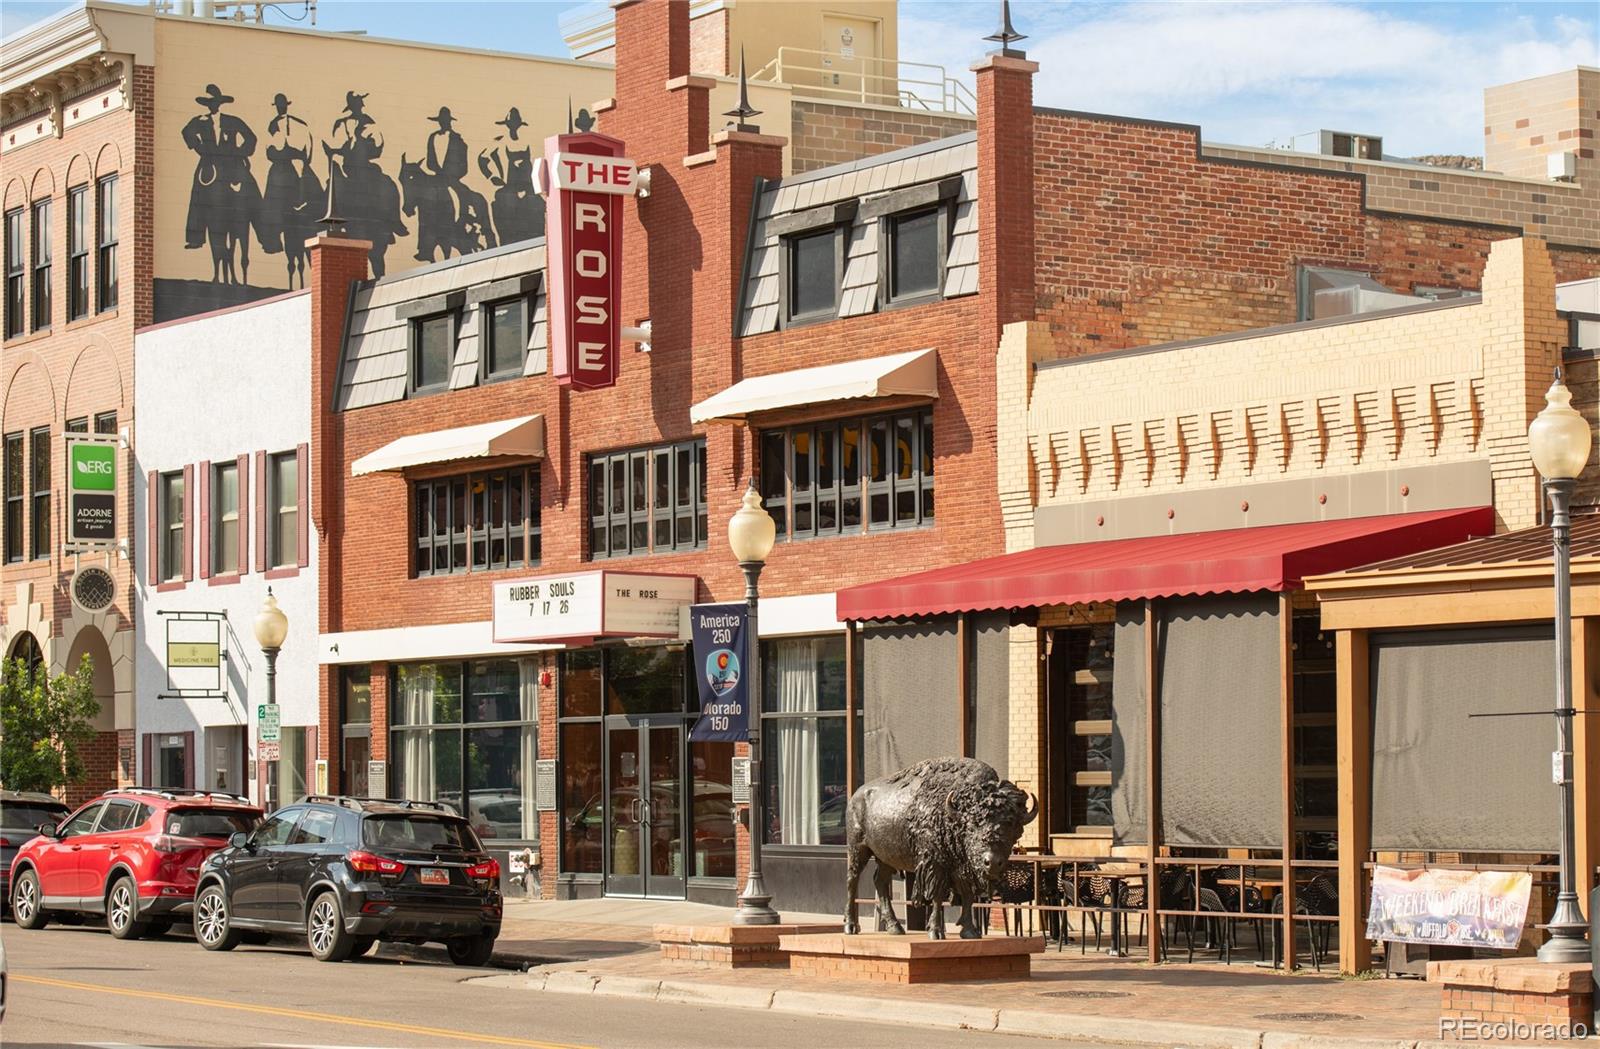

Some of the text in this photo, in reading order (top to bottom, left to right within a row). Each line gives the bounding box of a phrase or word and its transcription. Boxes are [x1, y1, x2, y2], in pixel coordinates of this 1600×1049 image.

[562, 160, 633, 186] THE
[575, 202, 609, 371] ROSE
[87, 461, 112, 475] ERG
[77, 508, 112, 518] ADORNE
[509, 581, 575, 602] RUBBER SOULS
[616, 589, 659, 599] THE ROSE
[529, 599, 569, 617] 7 17 26
[700, 614, 740, 629] America
[712, 629, 732, 644] 250
[258, 707, 265, 718] 2
[703, 701, 742, 715] olorado
[710, 716, 729, 731] 150
[1379, 889, 1522, 928] WEEKEND BREAKFAST
